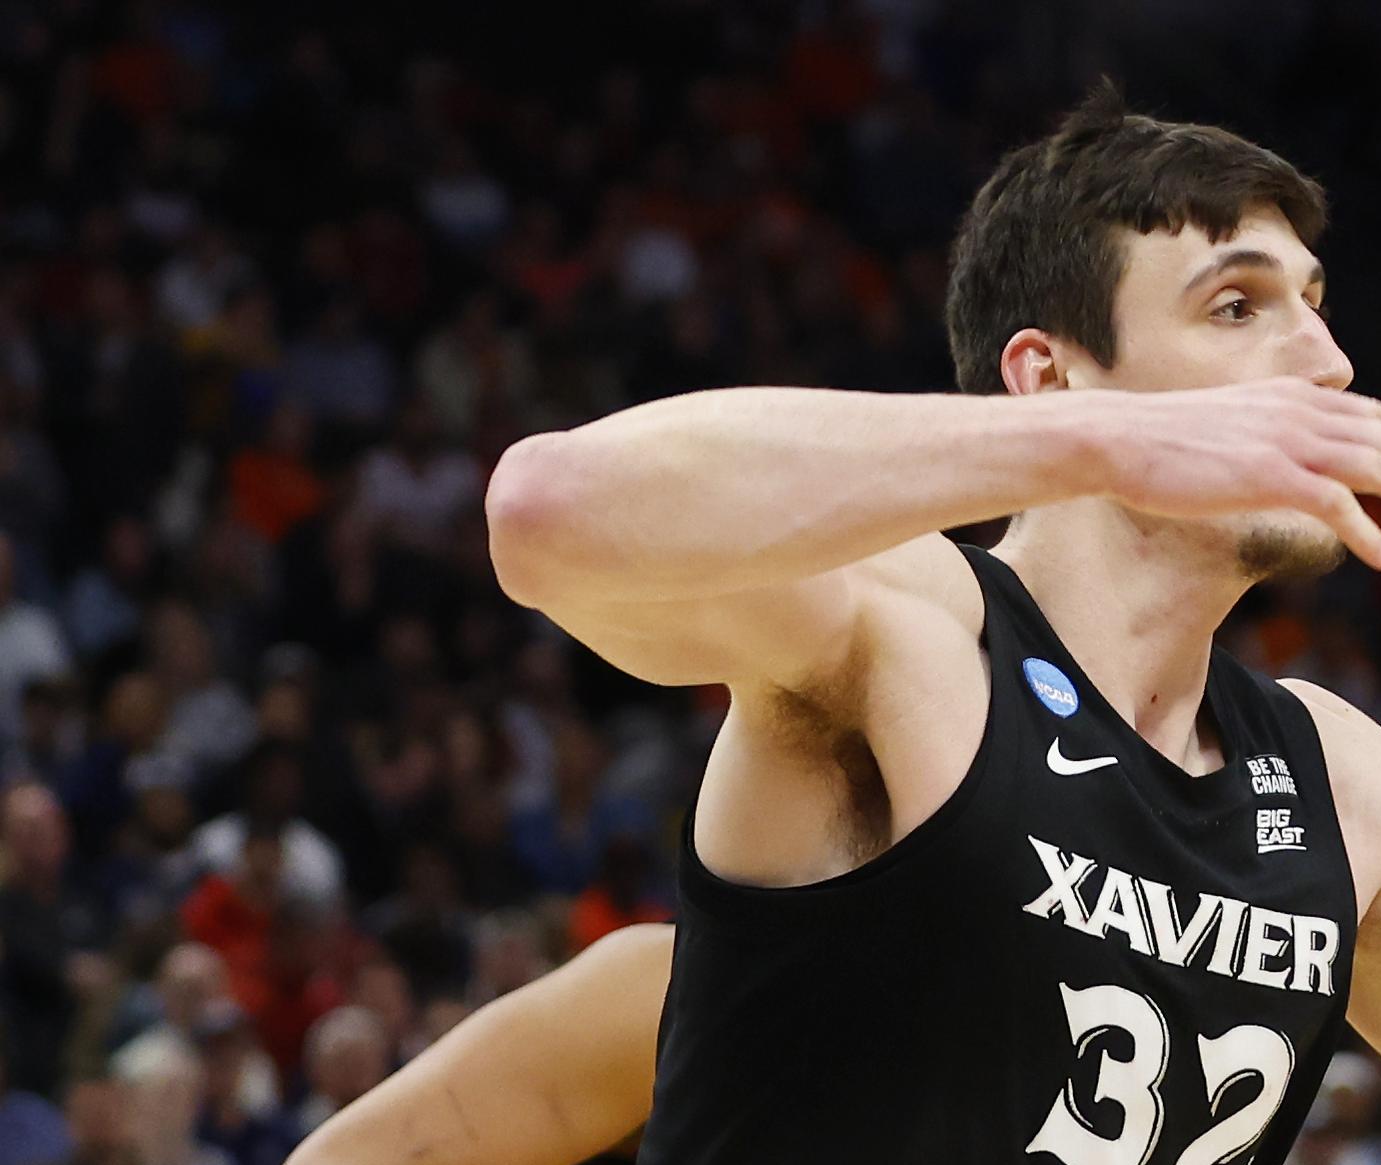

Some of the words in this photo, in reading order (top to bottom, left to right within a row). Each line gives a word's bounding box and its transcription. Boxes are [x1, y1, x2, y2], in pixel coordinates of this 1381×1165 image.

[1032, 679, 1076, 706] NCAA
[1246, 757, 1271, 777] BE
[1256, 808, 1292, 829] BIG
[1256, 826, 1306, 846] EAST
[1022, 834, 1340, 997] XAVIER
